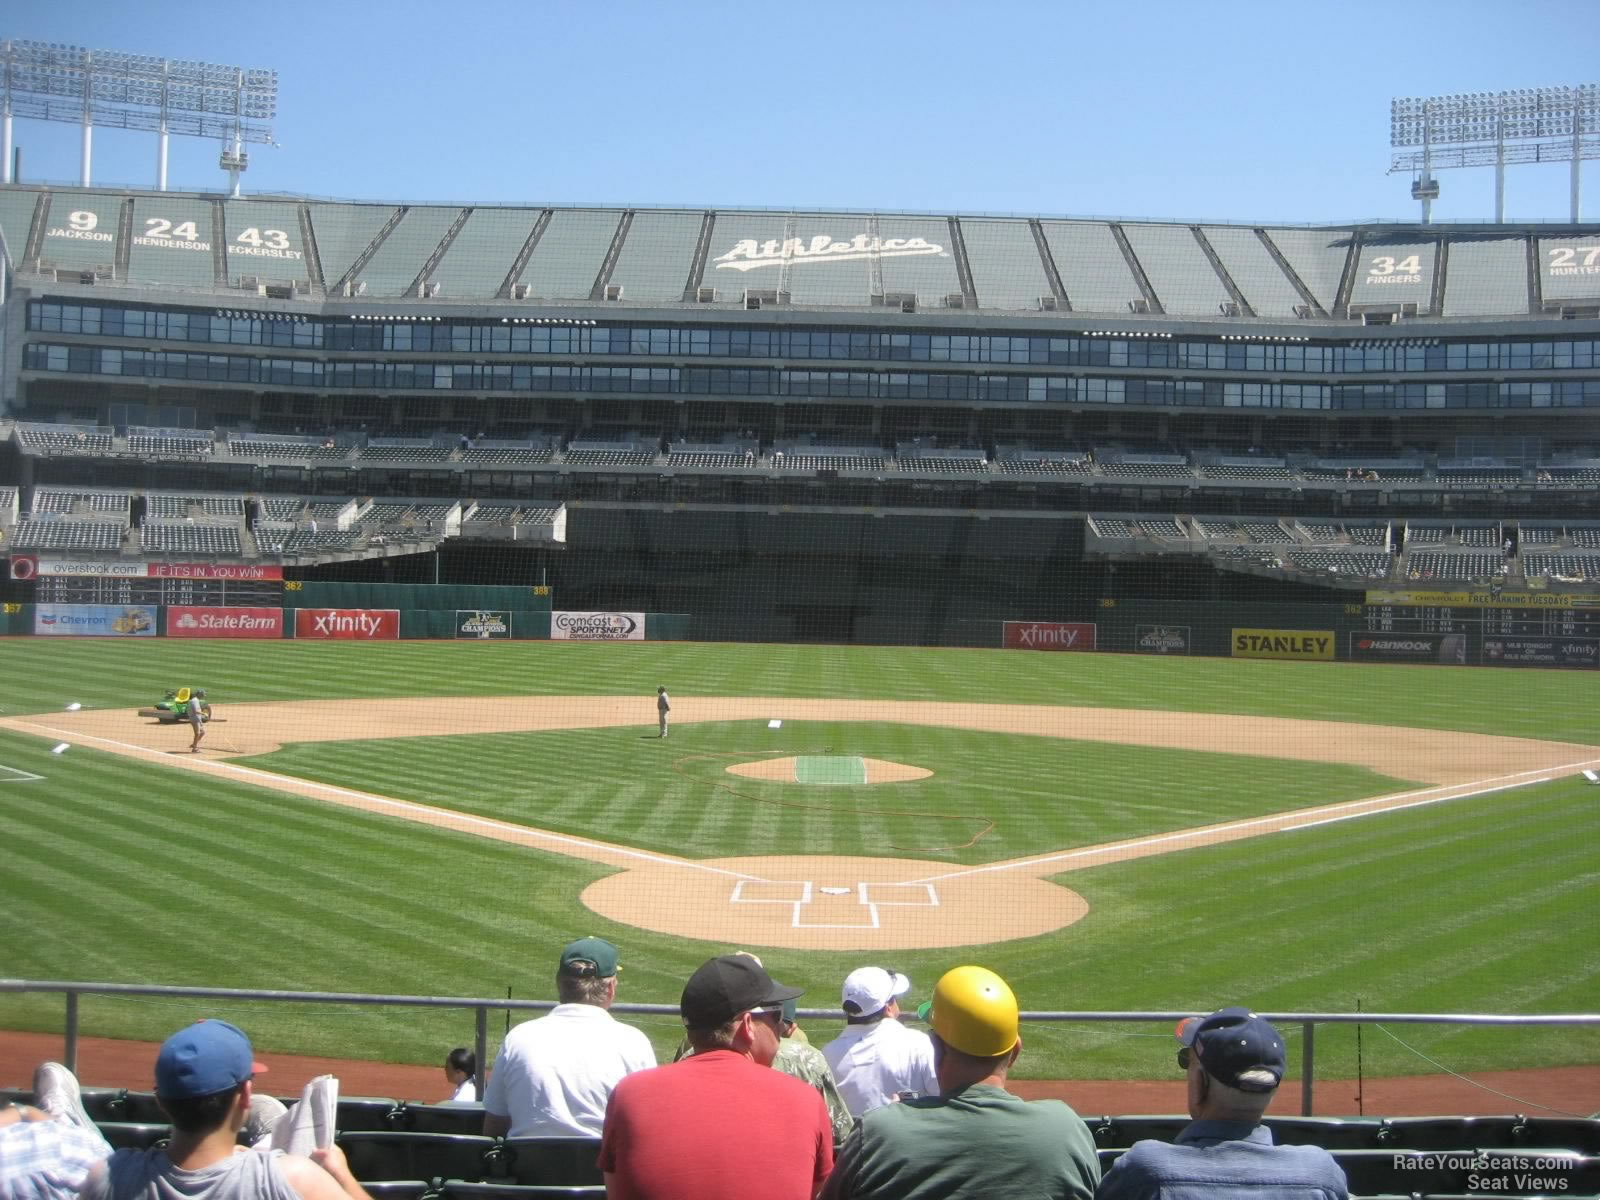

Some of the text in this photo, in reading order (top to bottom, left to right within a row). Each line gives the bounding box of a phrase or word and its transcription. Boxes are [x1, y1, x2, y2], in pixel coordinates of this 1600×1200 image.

[69, 210, 98, 231] 9
[47, 228, 113, 242] JACKSON
[146, 217, 199, 241] 24
[133, 236, 210, 251] HENDERSON
[237, 227, 290, 250] 43
[229, 245, 302, 260] ECKERSLEY
[713, 234, 944, 269] Athletics
[1549, 246, 1600, 267] 27
[1369, 255, 1422, 275] 34
[1366, 274, 1422, 284] FINGERS
[54, 563, 137, 575] overstock.com
[156, 565, 167, 577] IF
[168, 565, 191, 577] IT'S
[211, 567, 236, 577] YOU
[238, 567, 264, 578] WIN!
[284, 581, 302, 591] 362
[1468, 594, 1489, 604] FREE
[1528, 595, 1569, 605] TUESDAYS
[60, 614, 107, 625] Chevron
[314, 612, 382, 636] xfinity
[461, 624, 507, 633] CHAMPIONS
[570, 626, 626, 634] SPORTSNET
[1020, 625, 1078, 647] xfinity
[1140, 638, 1185, 648] CHAMPIONS
[1237, 634, 1329, 653] STANLEY
[1562, 644, 1598, 657] xfinity
